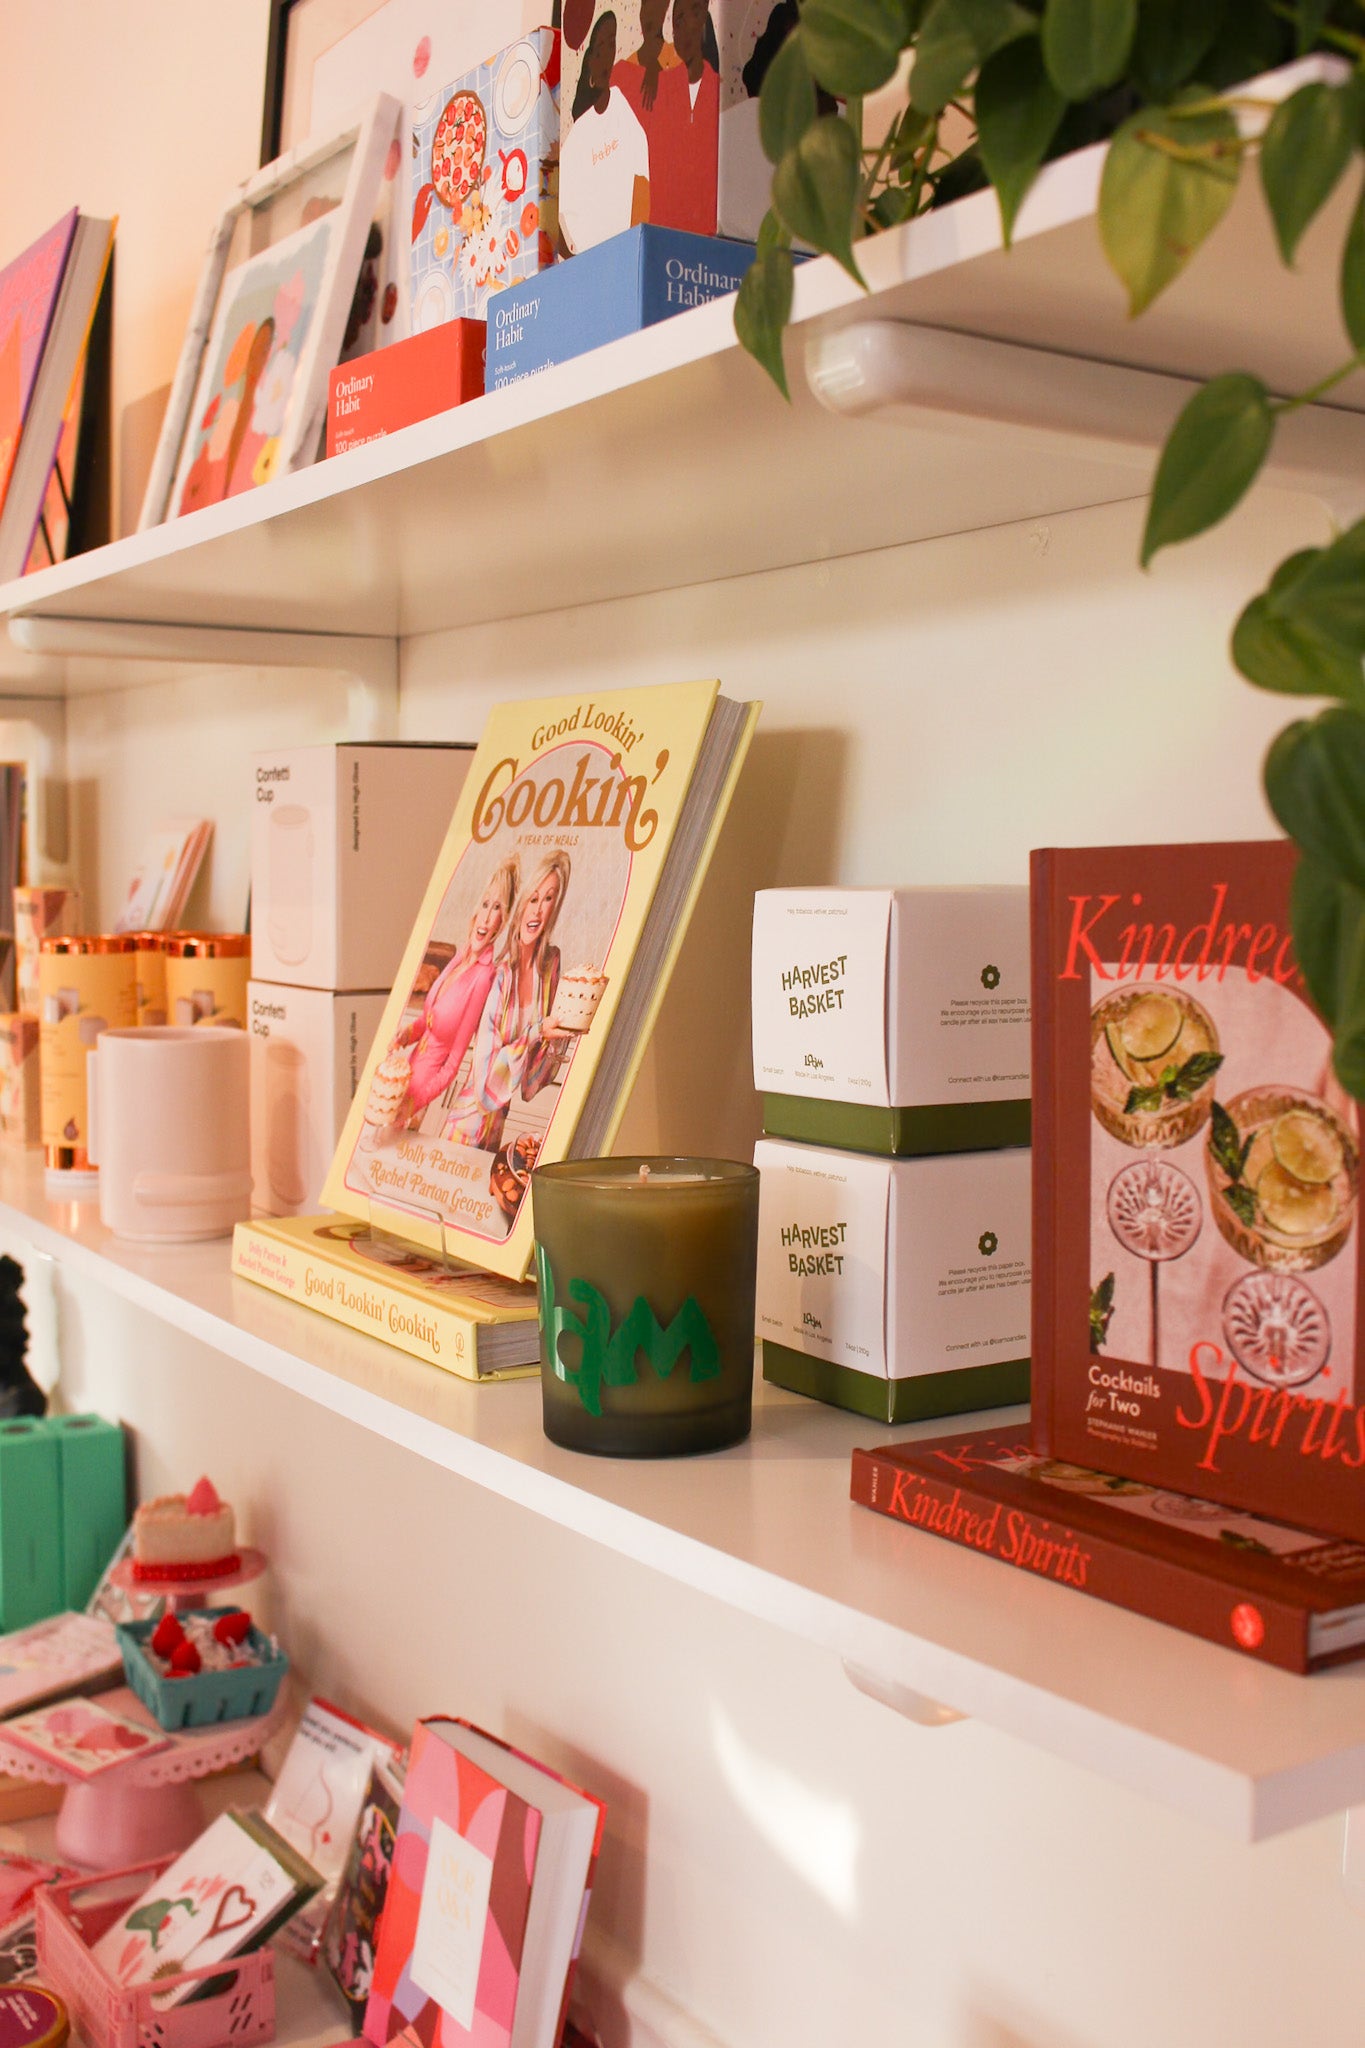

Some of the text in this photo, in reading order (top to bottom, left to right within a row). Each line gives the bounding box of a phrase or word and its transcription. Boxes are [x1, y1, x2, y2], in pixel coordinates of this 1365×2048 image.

[666, 259, 742, 290] Ordinar
[496, 298, 540, 328] Ordinary
[496, 324, 523, 350] Habit
[336, 374, 375, 398] Ordinary
[336, 396, 360, 417] Habit
[336, 441, 347, 454] 100
[532, 704, 644, 752] Good Lookin'
[257, 767, 290, 782] Confetti
[257, 788, 274, 804] Cup
[472, 749, 670, 851] Cookin'
[516, 835, 579, 846] A YEAR OF MEALS
[782, 955, 848, 991] HARVEST
[253, 1001, 286, 1020] Confetti
[789, 989, 845, 1019] BASKET
[253, 1020, 270, 1038] Cup
[396, 1139, 482, 1181] Dolly Parton &
[370, 1159, 493, 1221] Rachel Parton George
[781, 1223, 847, 1248] HARVEST
[789, 1253, 844, 1276] BASKET
[305, 1267, 440, 1354] Good Lookin' Cookin'
[946, 1343, 969, 1352] Connect
[1088, 1366, 1161, 1398] Cocktails
[1086, 1390, 1140, 1416] for Two
[1176, 1341, 1365, 1472] Spirits
[888, 1467, 1091, 1586] Kindred Spirits
